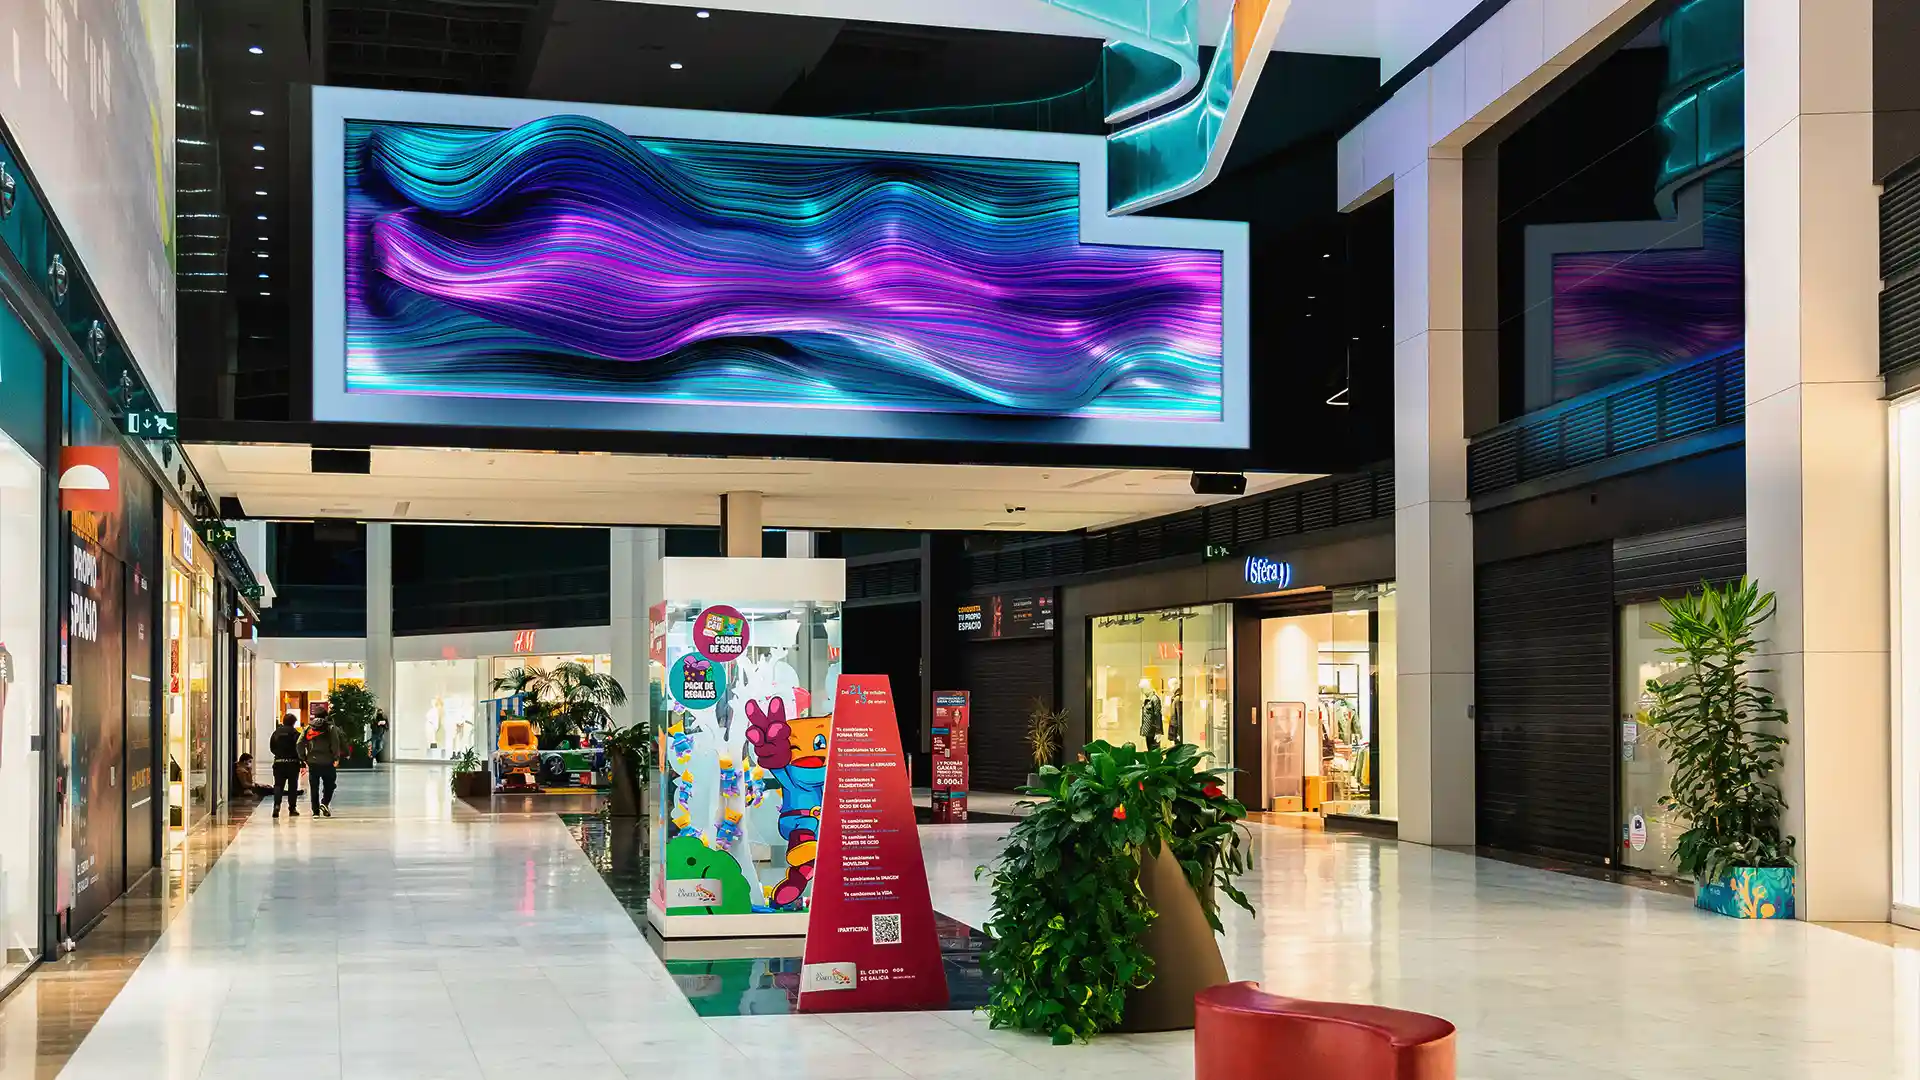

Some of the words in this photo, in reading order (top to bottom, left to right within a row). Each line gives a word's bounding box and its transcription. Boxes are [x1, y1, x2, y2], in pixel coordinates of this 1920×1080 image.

[74, 544, 96, 588] PROPIO
[71, 591, 98, 642] SPACIO
[965, 612, 981, 620] PROPIO
[958, 621, 982, 630] ESPACIO
[715, 636, 742, 645] CARNET
[720, 645, 742, 653] SOCIO
[684, 682, 703, 690] PACK
[704, 682, 714, 690] DE
[850, 684, 862, 694] 21
[860, 694, 867, 704] 5
